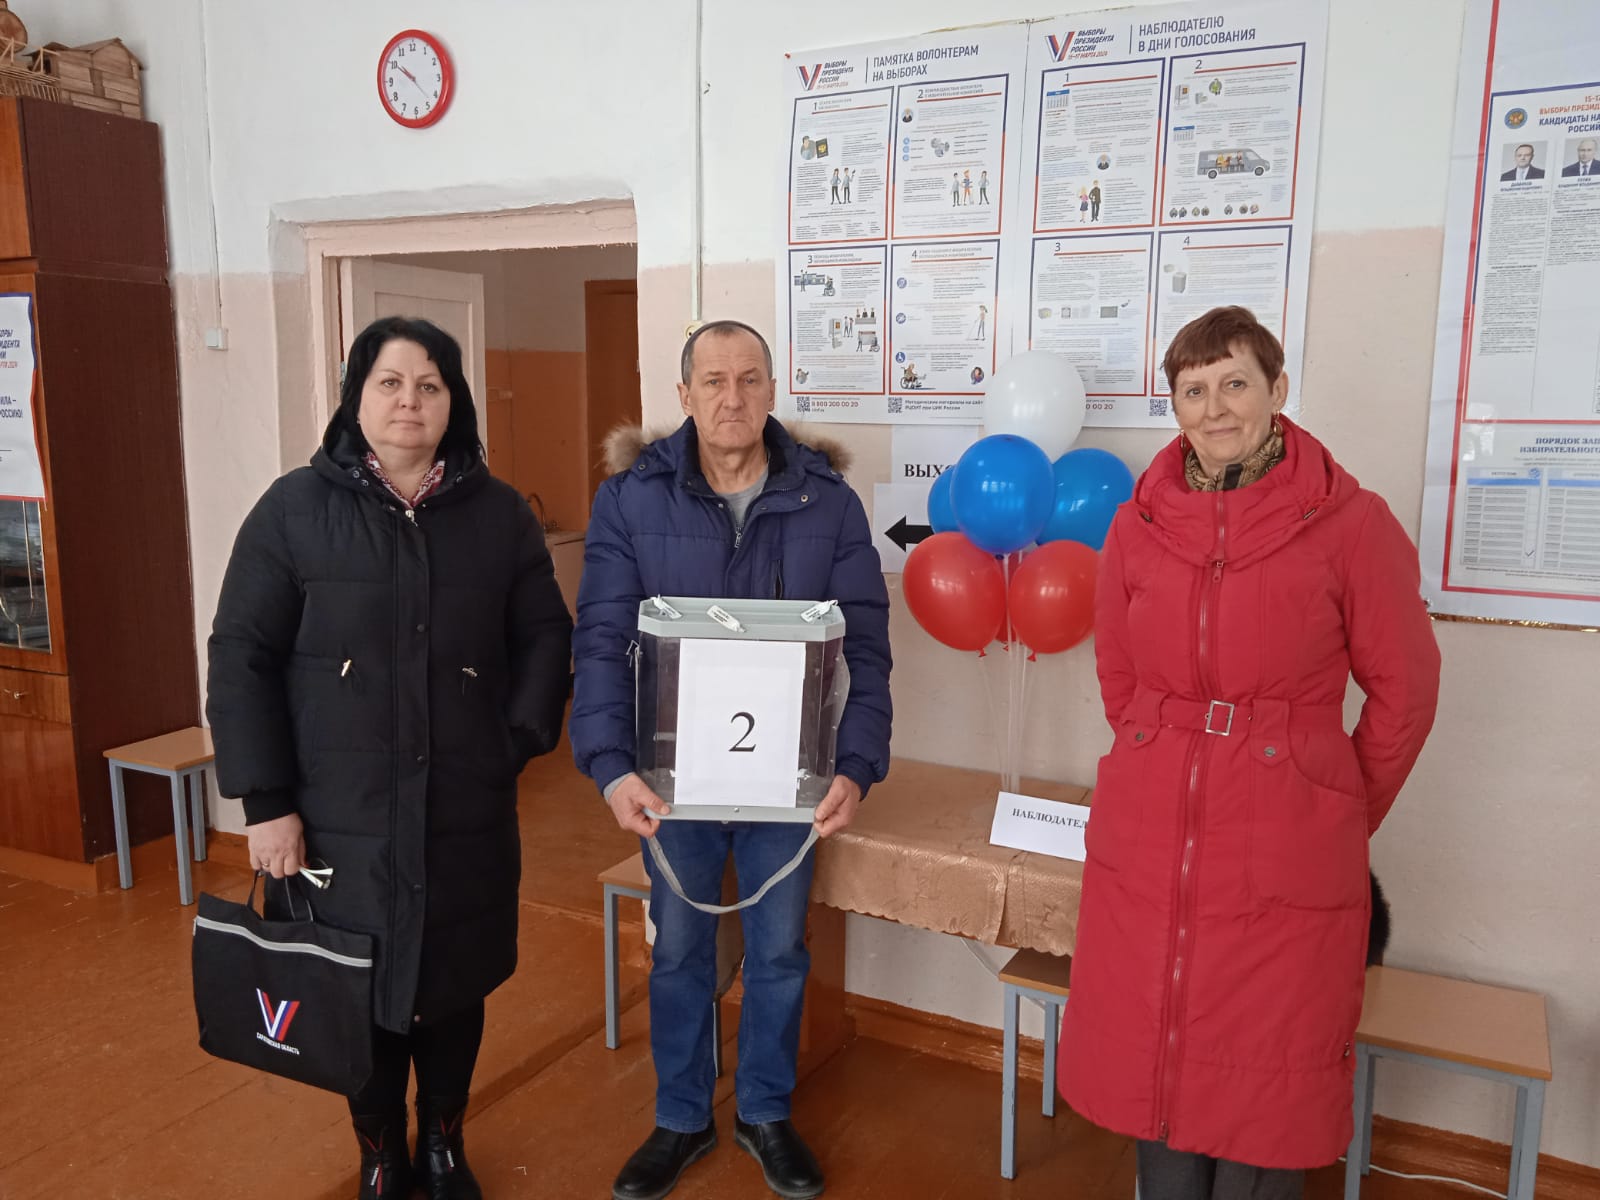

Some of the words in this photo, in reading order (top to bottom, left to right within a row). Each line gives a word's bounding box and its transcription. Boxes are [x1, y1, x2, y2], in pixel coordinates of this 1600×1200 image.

[1139, 16, 1224, 36] НАБЛЮДАТЕЛЮ
[1078, 28, 1106, 36] ВЫБОРЫ
[1074, 35, 1114, 45] ПРЕЗИДЕНТА
[1138, 40, 1145, 52] В
[1148, 38, 1171, 52] ДНИ
[1175, 28, 1256, 48] ГОЛОСОВАНИЯ
[409, 43, 416, 51] 12
[423, 47, 427, 55] 1
[1071, 45, 1096, 53] РОССИИ
[398, 48, 405, 56] 11
[873, 52, 914, 68] ПАМЯТКА
[916, 45, 979, 62] ВОЛОНТЕРАМ
[391, 61, 398, 69] 10
[432, 57, 437, 66] 2
[824, 60, 848, 69] ВЫБОРЫ
[1195, 60, 1202, 69] 2
[822, 67, 854, 76] ПРЕЗИДЕНТА
[872, 71, 884, 82] НА
[886, 64, 928, 80] ВЫБОРАХ
[389, 77, 393, 87] 9
[437, 74, 441, 82] 3
[819, 76, 839, 84] РОССИИ
[1065, 73, 1069, 82] 1
[393, 92, 398, 101] 8
[433, 90, 438, 98] 4
[918, 89, 924, 99] 2
[402, 103, 407, 111] 7
[425, 101, 430, 110] 5
[813, 101, 817, 111] 1
[1539, 105, 1570, 115] ВЫБОРЫ
[414, 106, 418, 115] 6
[1539, 115, 1589, 126] КАНДИДАТЫ
[1183, 236, 1190, 246] 4
[1055, 242, 1061, 252] 3
[911, 249, 917, 259] 4
[808, 255, 813, 264] 3
[1535, 437, 1580, 445] ПОРЯДОК
[904, 463, 953, 478] ВЫХ
[728, 711, 757, 752] 2
